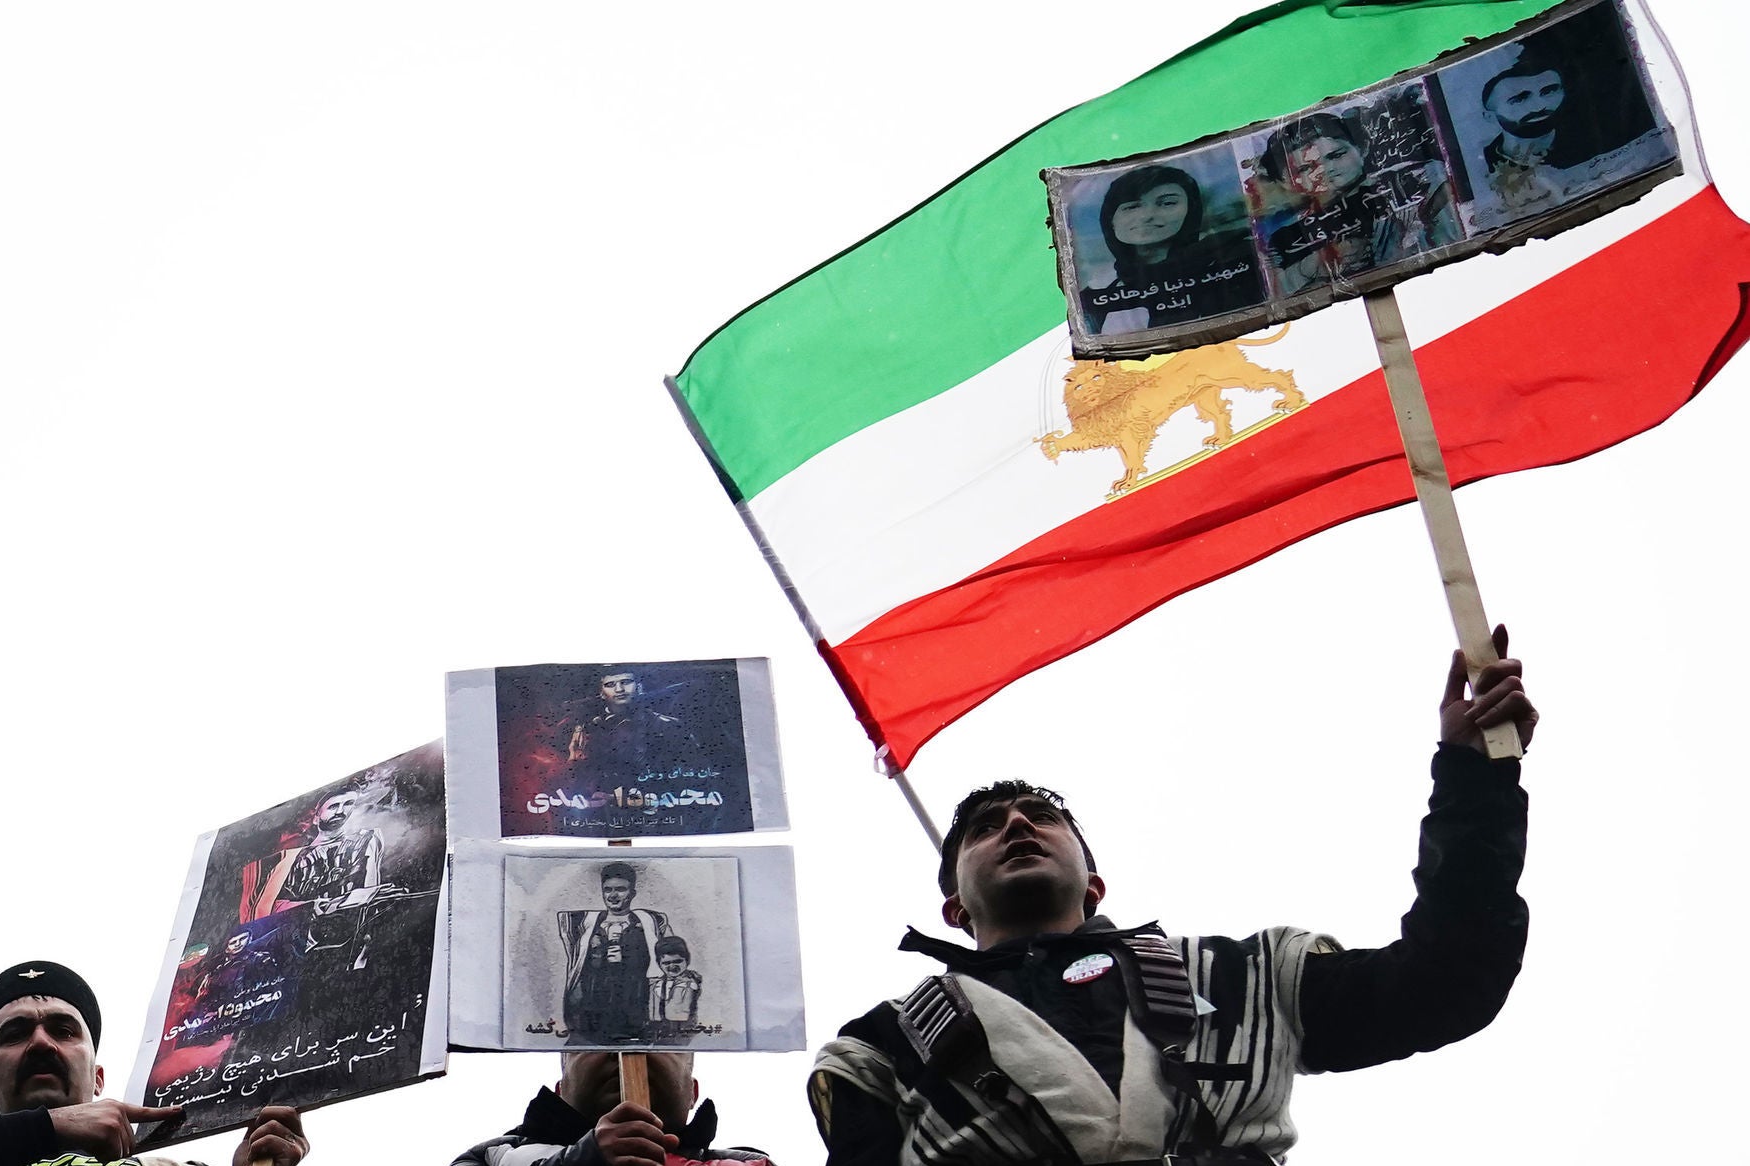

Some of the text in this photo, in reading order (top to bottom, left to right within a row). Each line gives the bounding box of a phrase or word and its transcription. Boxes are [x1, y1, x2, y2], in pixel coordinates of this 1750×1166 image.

[1093, 262, 1250, 306] شهید دنیا فرهادی
[1156, 294, 1192, 312] ایذه
[155, 1012, 407, 1098] این سر برای هیچ رژیمی
[241, 1051, 340, 1096] شدنی
[348, 1041, 396, 1074] خم
